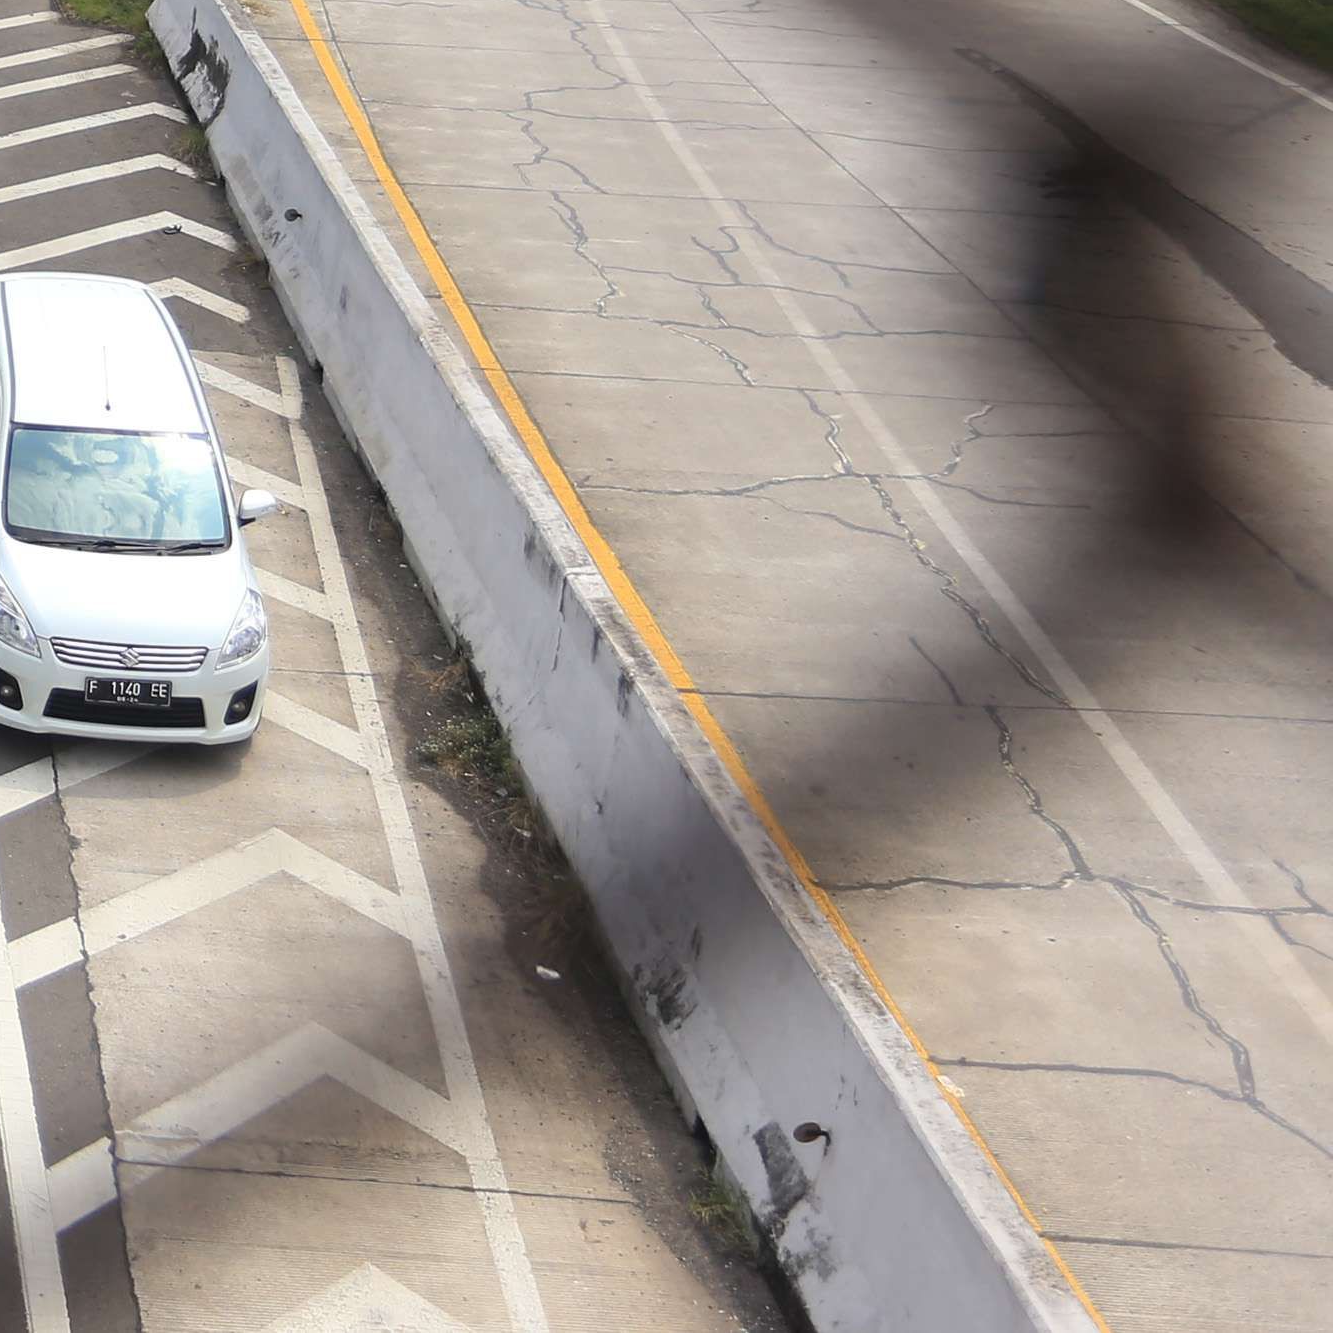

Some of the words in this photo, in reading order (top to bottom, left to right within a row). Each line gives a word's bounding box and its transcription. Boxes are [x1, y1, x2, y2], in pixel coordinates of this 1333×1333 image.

[89, 680, 98, 694] F
[112, 681, 141, 696] 1140
[151, 683, 167, 698] EE
